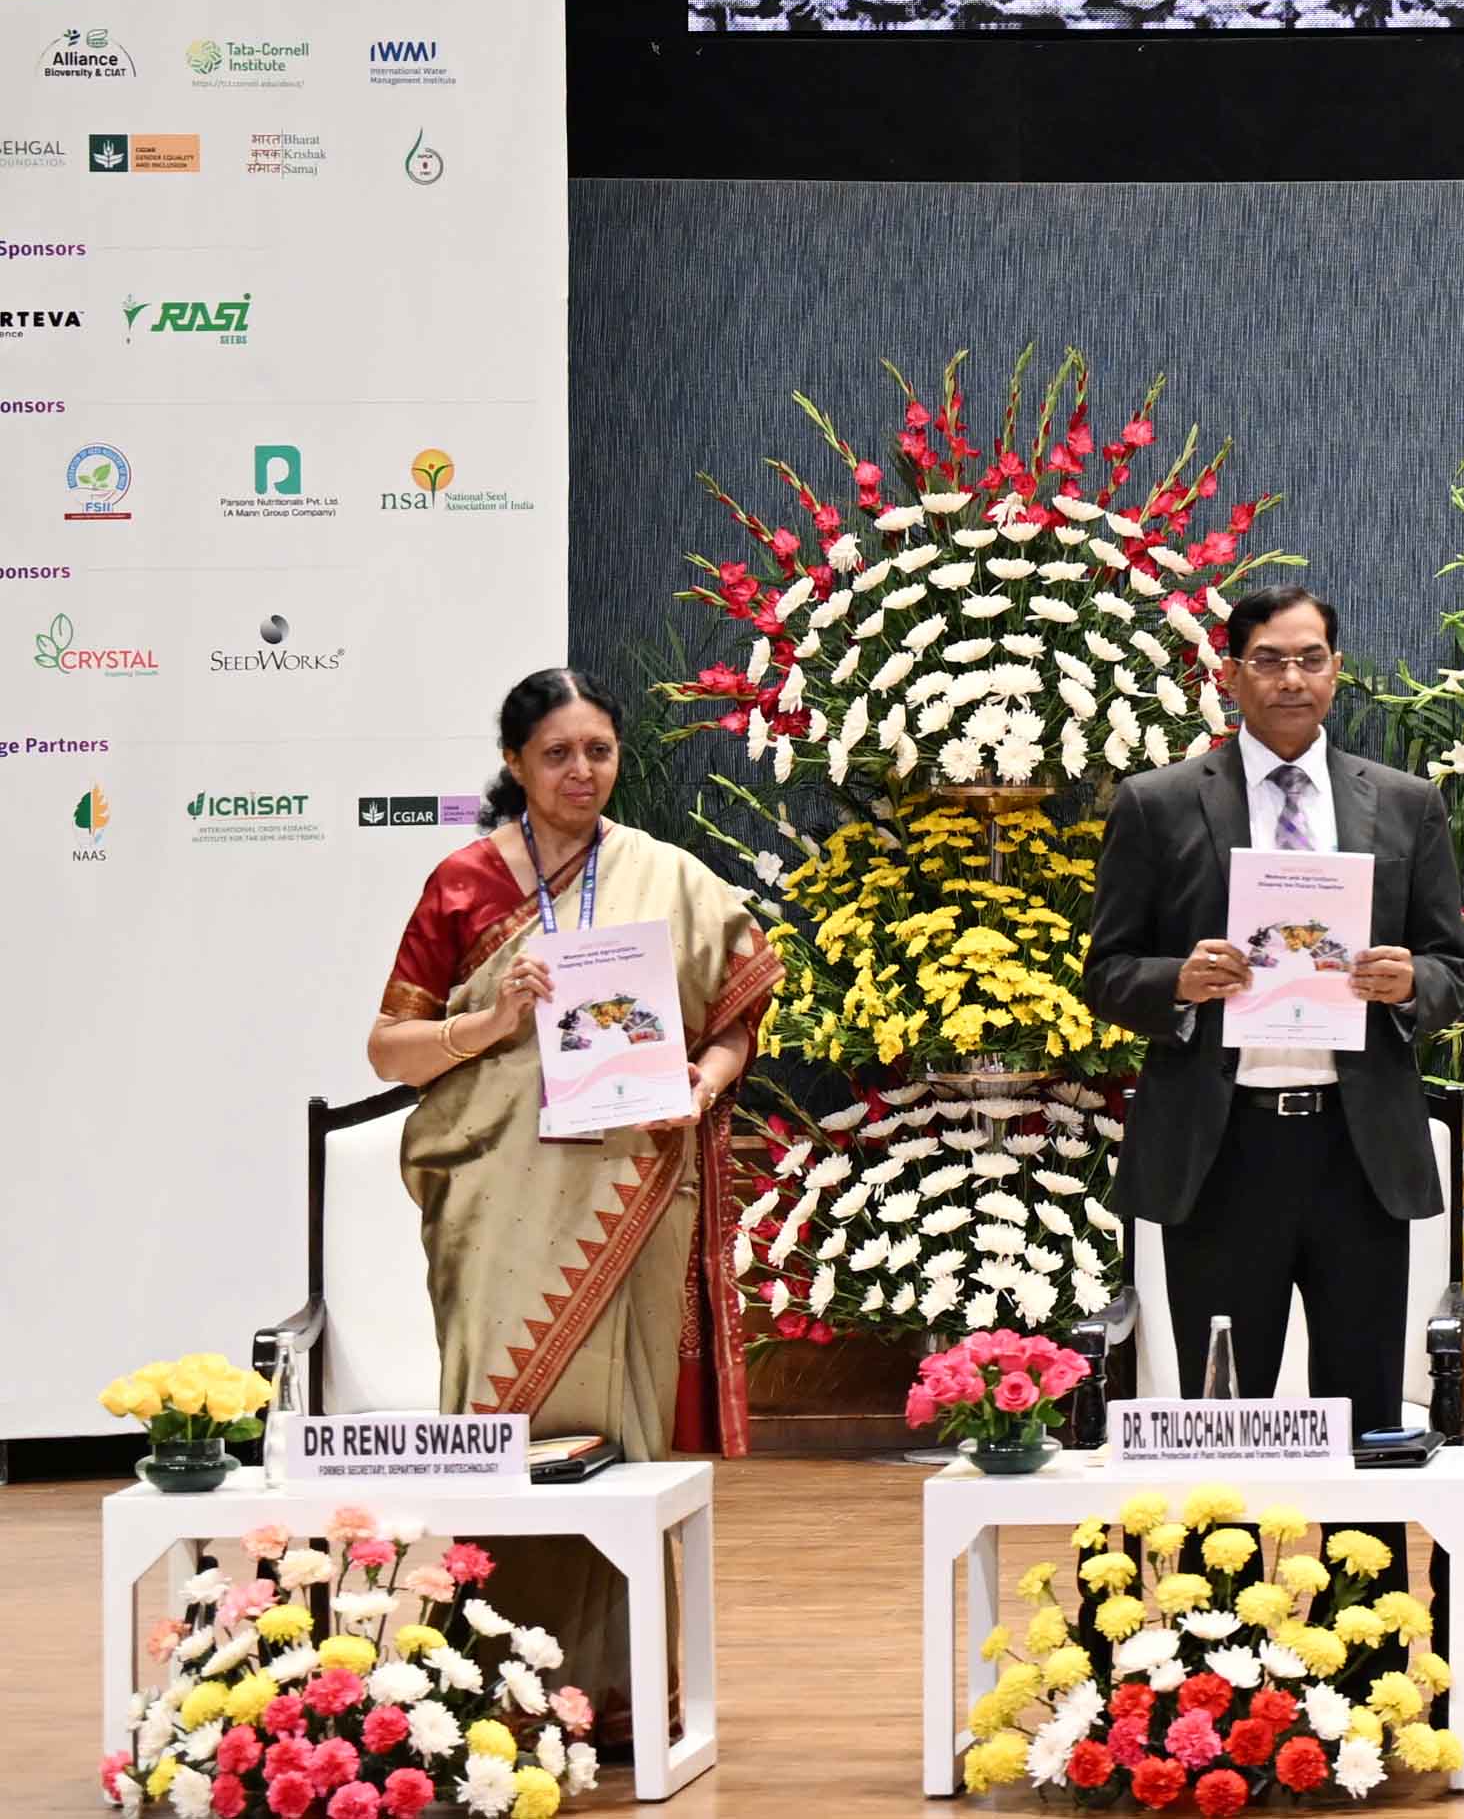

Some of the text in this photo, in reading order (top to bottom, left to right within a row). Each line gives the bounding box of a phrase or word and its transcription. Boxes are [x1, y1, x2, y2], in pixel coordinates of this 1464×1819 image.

[228, 42, 309, 56] Tata-Cornell
[53, 52, 118, 67] Alliance
[229, 59, 285, 71] Institute
[61, 649, 159, 670] CRYSTAL
[208, 792, 309, 818] ICRISAT
[393, 811, 433, 823] CGIAR
[73, 850, 106, 861] NAAS
[1123, 1410, 1328, 1449] DR. TRILOCHAN MOHAPATRA
[304, 1423, 512, 1456] DR RENU SWARUP
